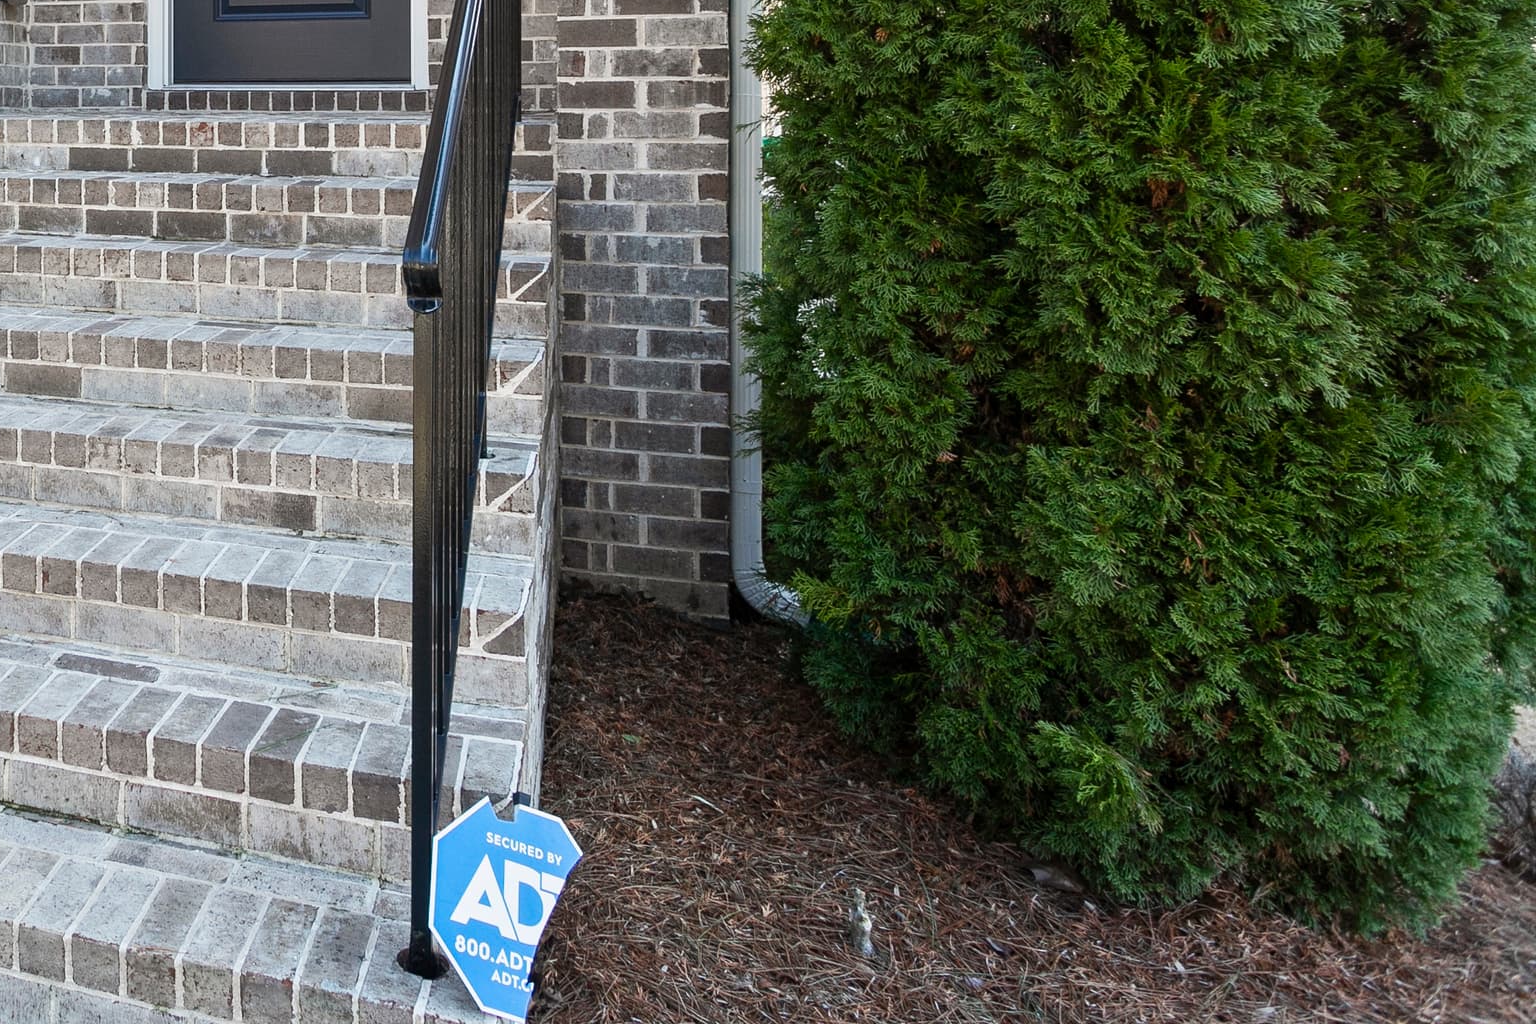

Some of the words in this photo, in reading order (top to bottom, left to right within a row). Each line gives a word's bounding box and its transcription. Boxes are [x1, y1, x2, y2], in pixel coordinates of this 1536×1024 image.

[486, 831, 544, 860] SECURED
[547, 851, 563, 867] BY
[491, 969, 535, 993] ADT.C
